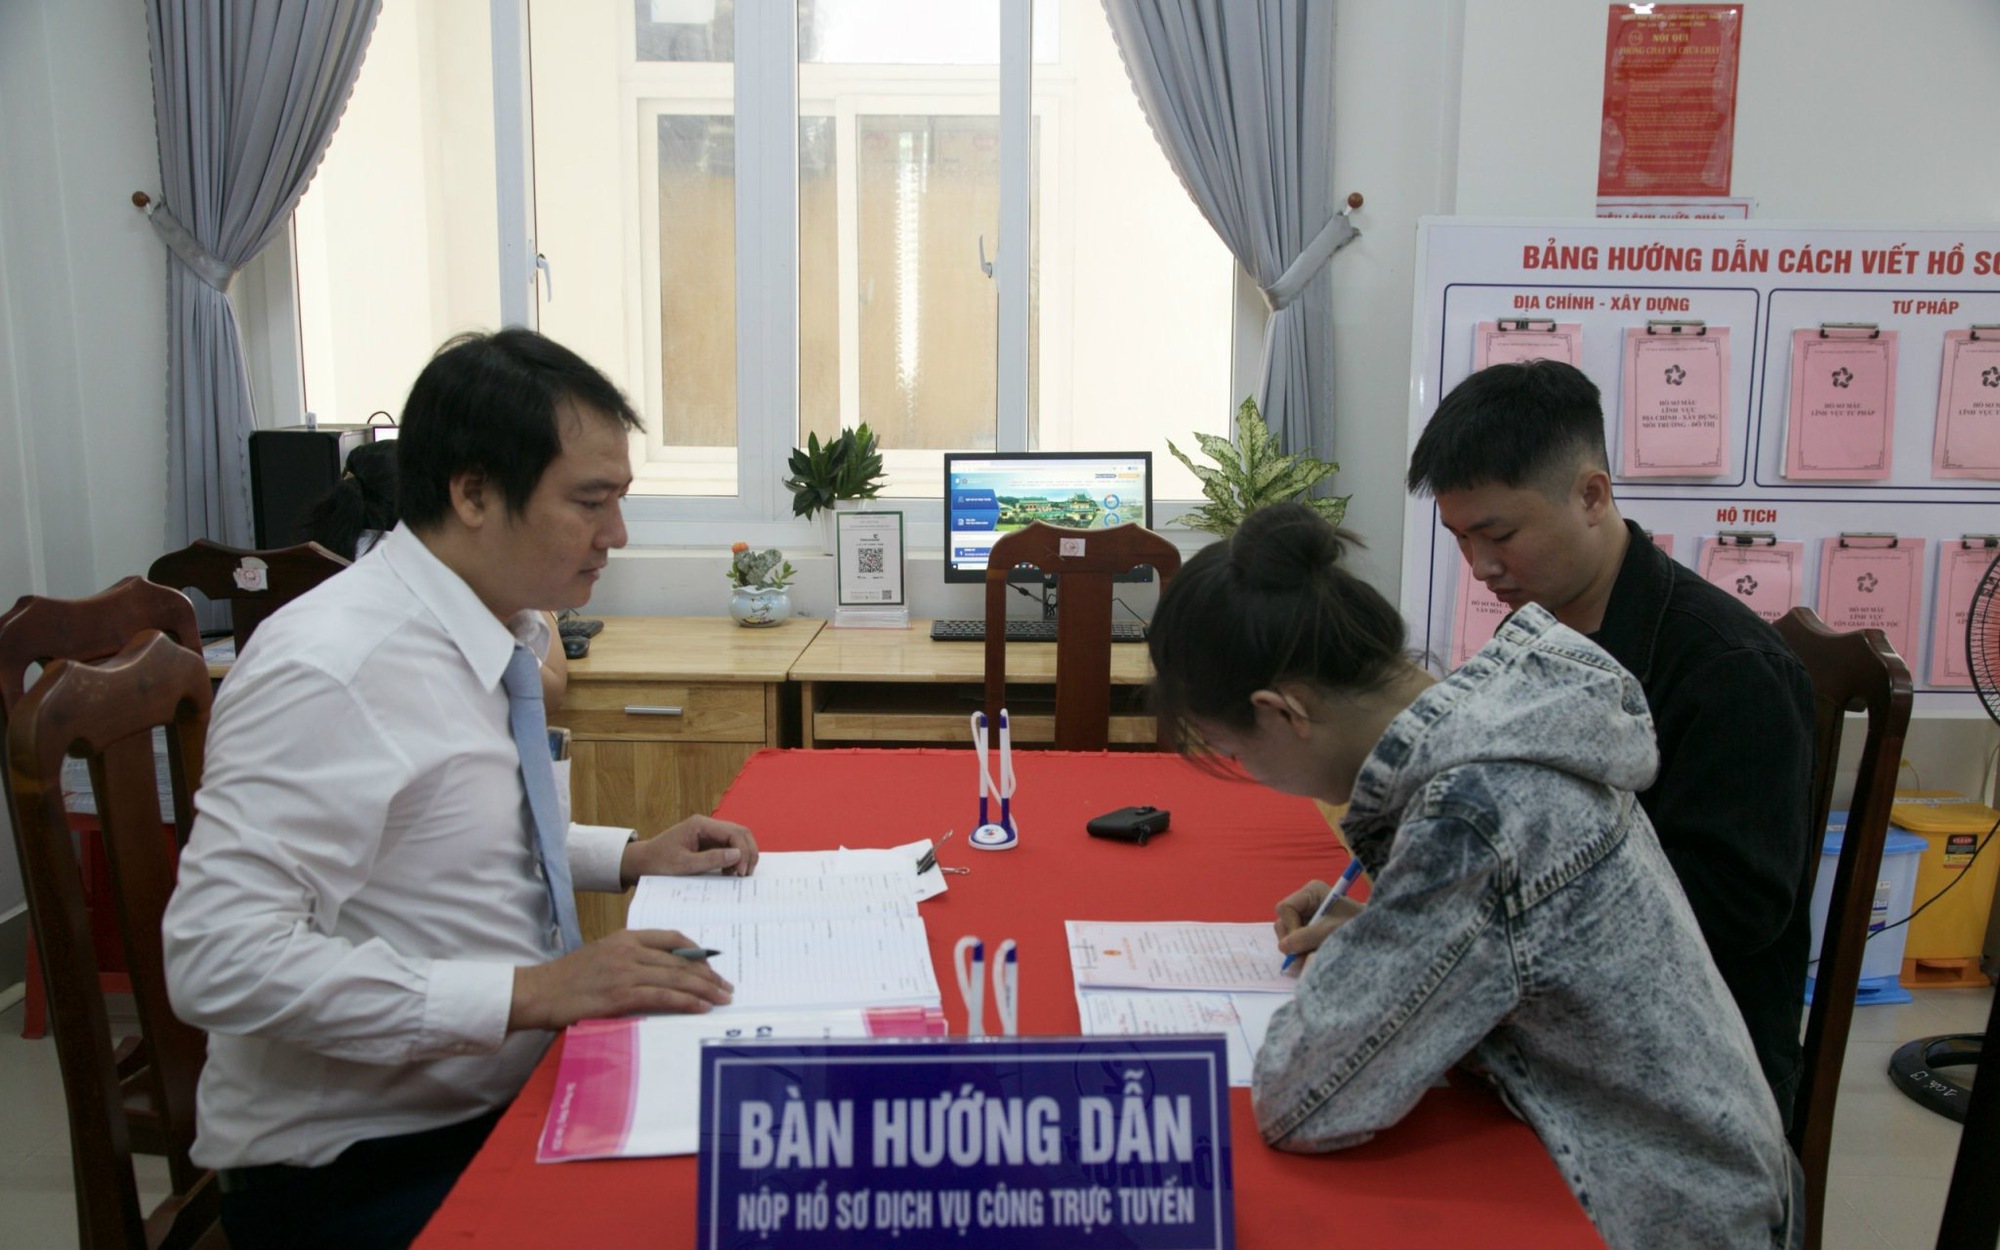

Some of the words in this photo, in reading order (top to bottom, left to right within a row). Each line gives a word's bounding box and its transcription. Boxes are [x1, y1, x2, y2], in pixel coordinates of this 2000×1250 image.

[1522, 237, 1598, 270] BẢNG
[1607, 242, 1702, 272] HƯỚNG
[1711, 239, 1769, 273] DẪN
[1778, 244, 1852, 274] CÁCH
[1861, 242, 1919, 275] VIẾT
[1927, 242, 1964, 275] HỒ
[1514, 295, 1540, 312] ĐỊA
[1545, 293, 1594, 310] CHÍNH
[1610, 294, 1641, 311] XÂY
[1645, 296, 1690, 314] DỰNG
[1892, 299, 1913, 315] TƯ
[1916, 298, 1960, 315] PHÁP
[1716, 507, 1738, 525] HỘ
[1743, 509, 1777, 526] TỊCH
[738, 1086, 854, 1168] BÀN
[872, 1083, 1062, 1168] HƯỚNG
[1080, 1069, 1193, 1165] DẪN
[738, 1186, 789, 1238] NỘP
[796, 1180, 829, 1230] HỒ
[835, 1187, 870, 1230] SƠ
[875, 1191, 933, 1237] DỊCH
[938, 1189, 971, 1236] VỤ
[977, 1182, 1044, 1227] CÔNG
[1050, 1186, 1113, 1234] TRỰC
[1117, 1174, 1195, 1226] TUYẾN
